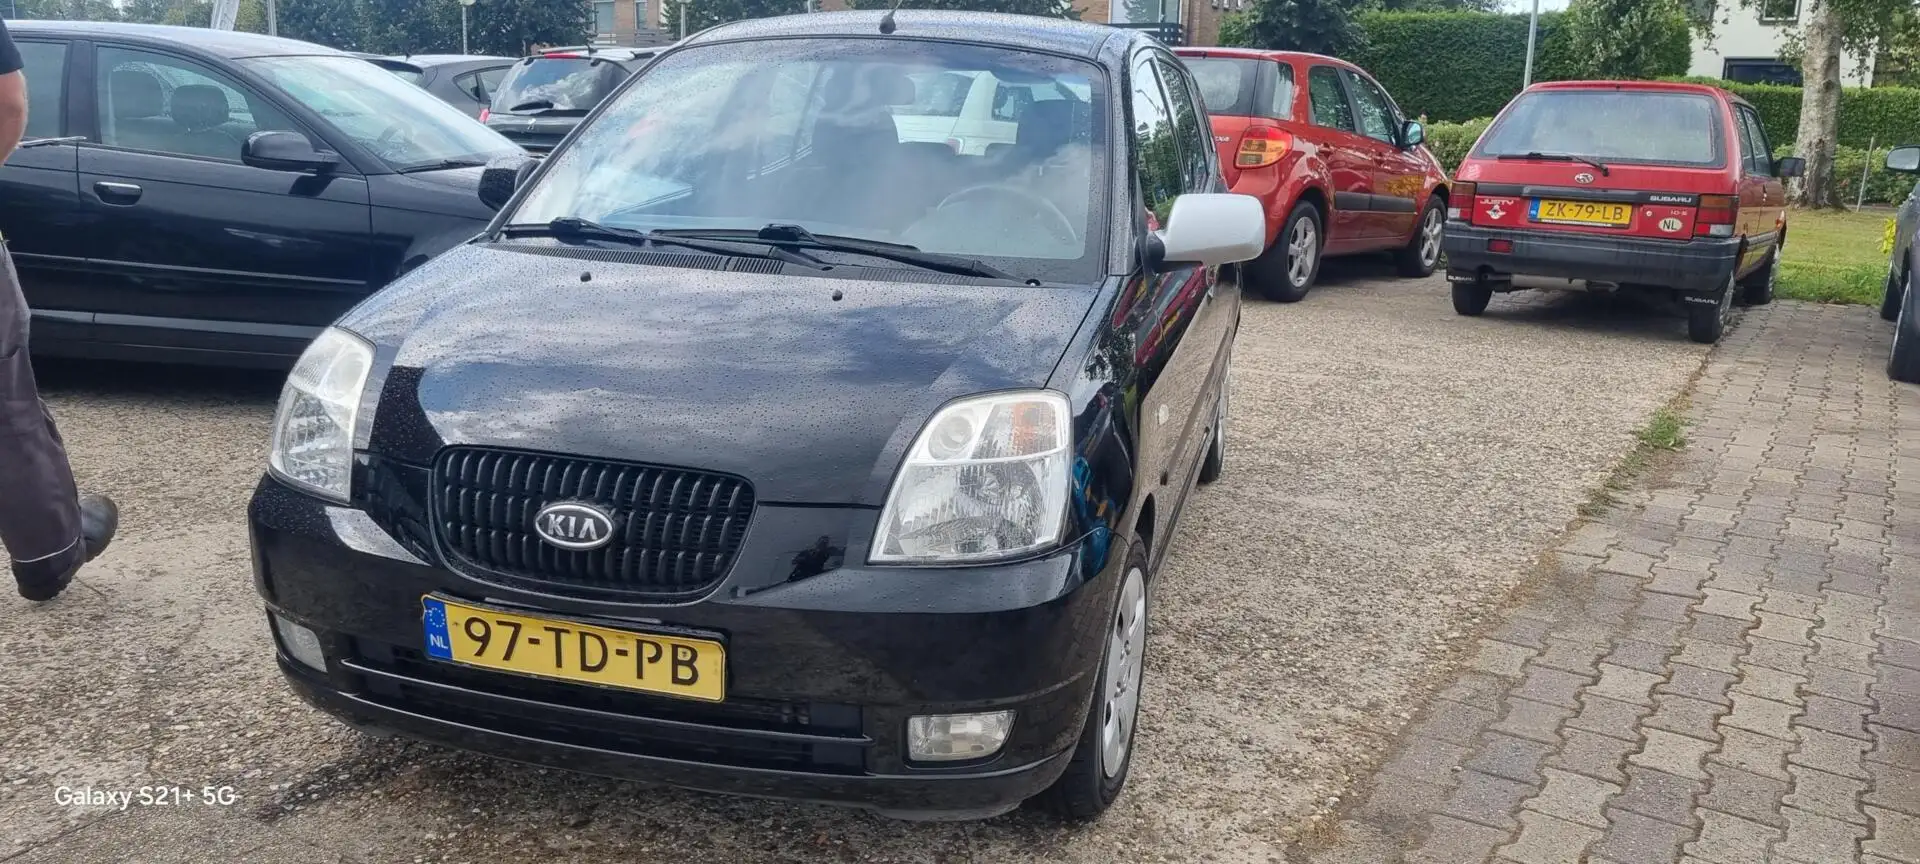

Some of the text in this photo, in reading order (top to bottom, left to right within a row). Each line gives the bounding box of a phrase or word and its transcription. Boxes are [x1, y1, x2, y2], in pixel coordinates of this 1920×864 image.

[1649, 195, 1692, 203] SUBARU
[1545, 202, 1624, 221] ZK-79-LB
[1662, 219, 1678, 231] NL
[547, 513, 598, 540] KIA
[429, 632, 449, 650] NL
[463, 616, 700, 687] 97-TD-PB
